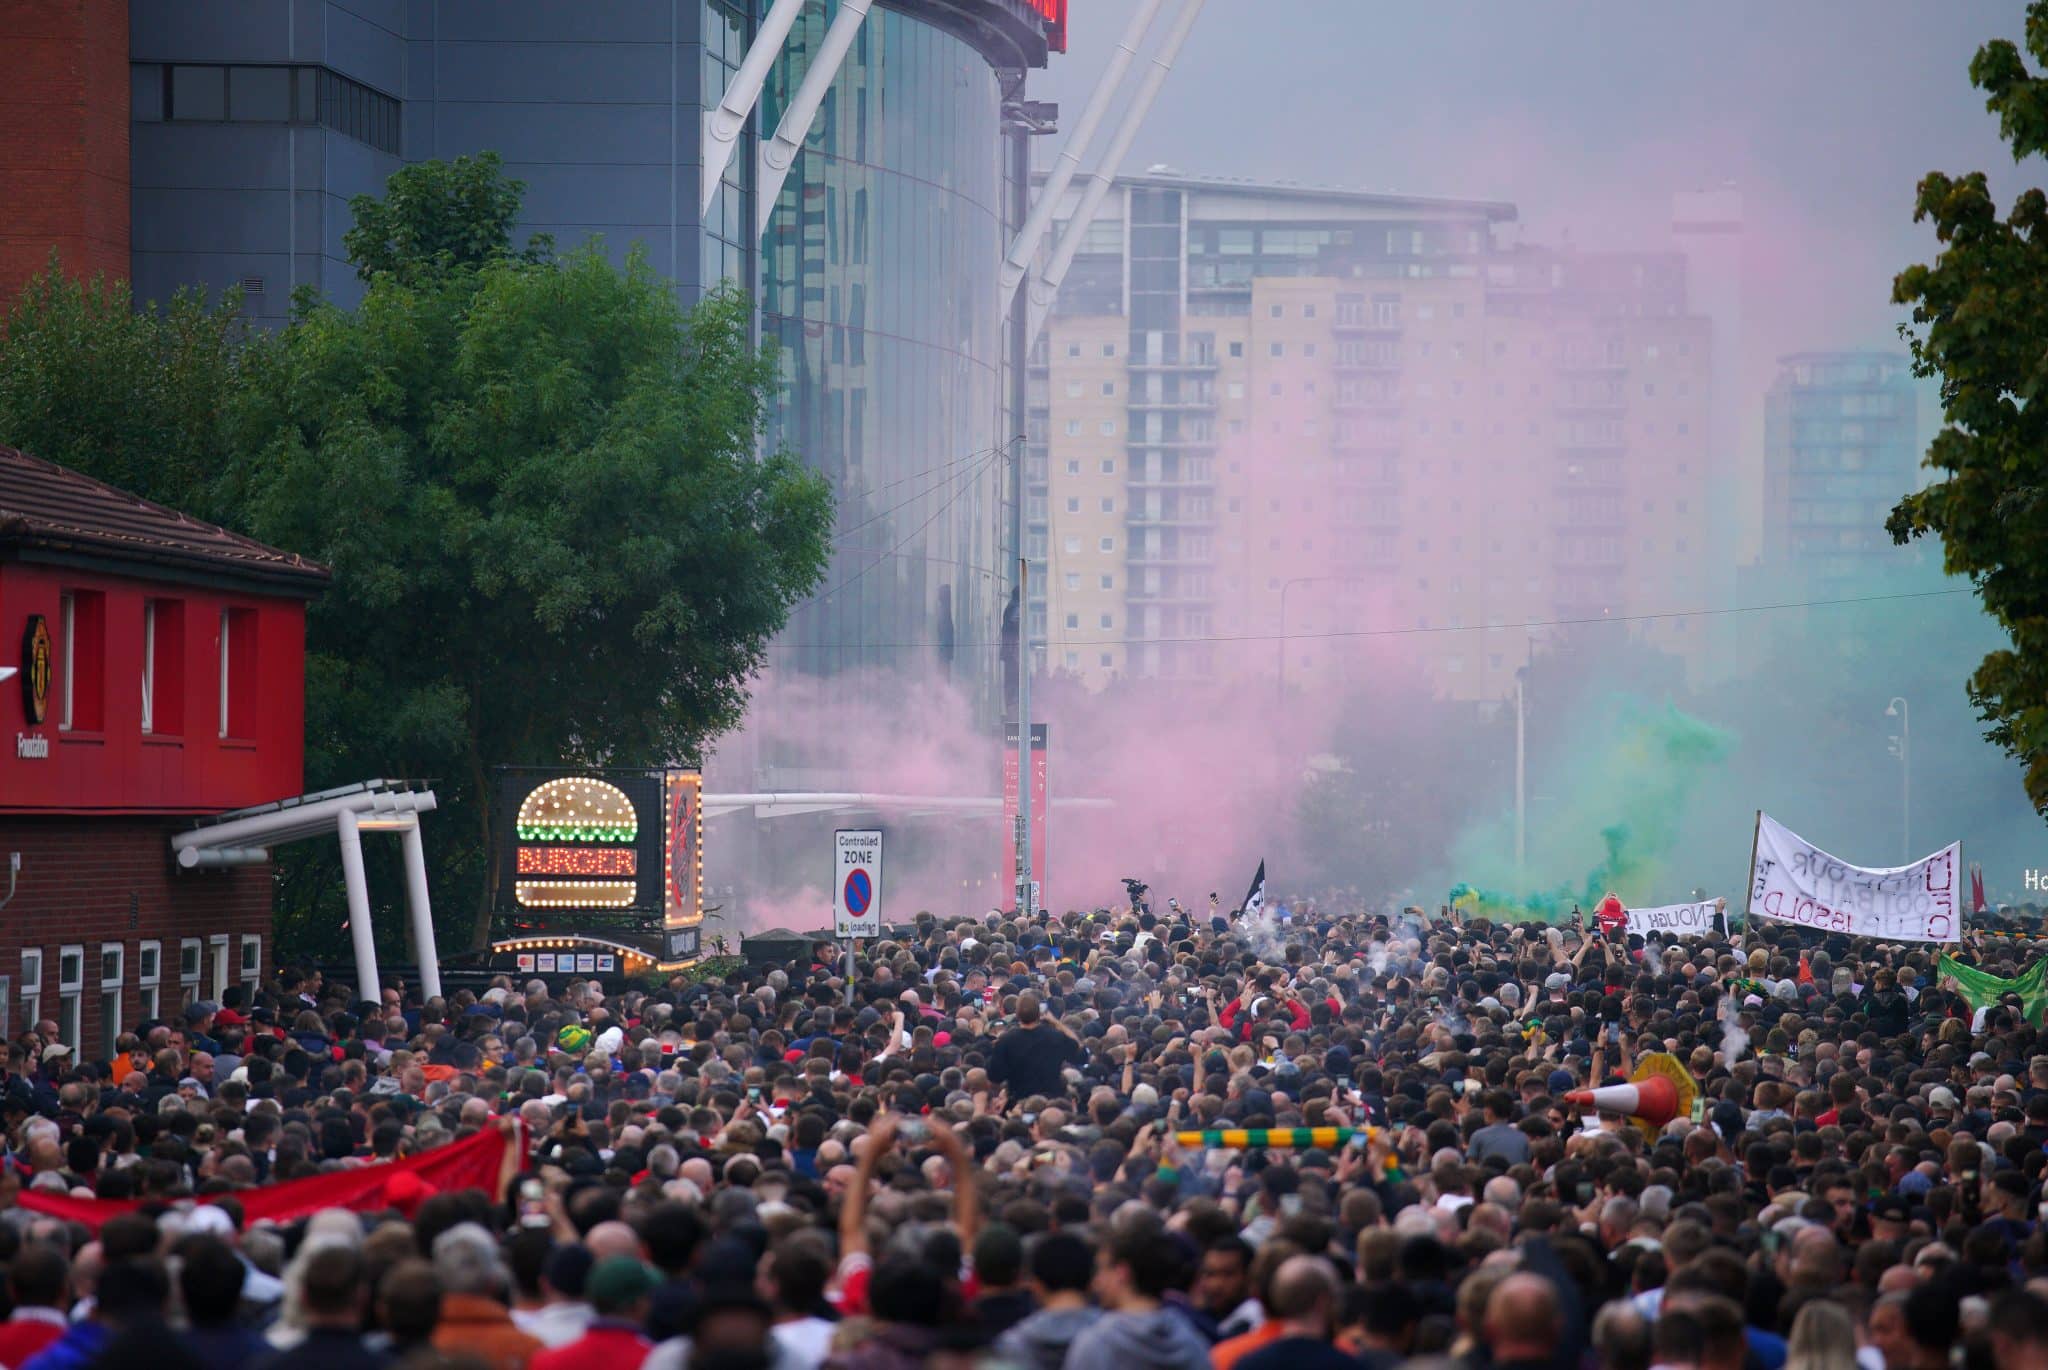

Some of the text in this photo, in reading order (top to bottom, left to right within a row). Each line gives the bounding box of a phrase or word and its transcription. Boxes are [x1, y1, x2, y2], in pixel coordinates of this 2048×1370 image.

[839, 836, 878, 846] Controlled
[517, 848, 635, 873] BURGER
[844, 851, 873, 863] ZONE
[850, 922, 876, 935] loading
